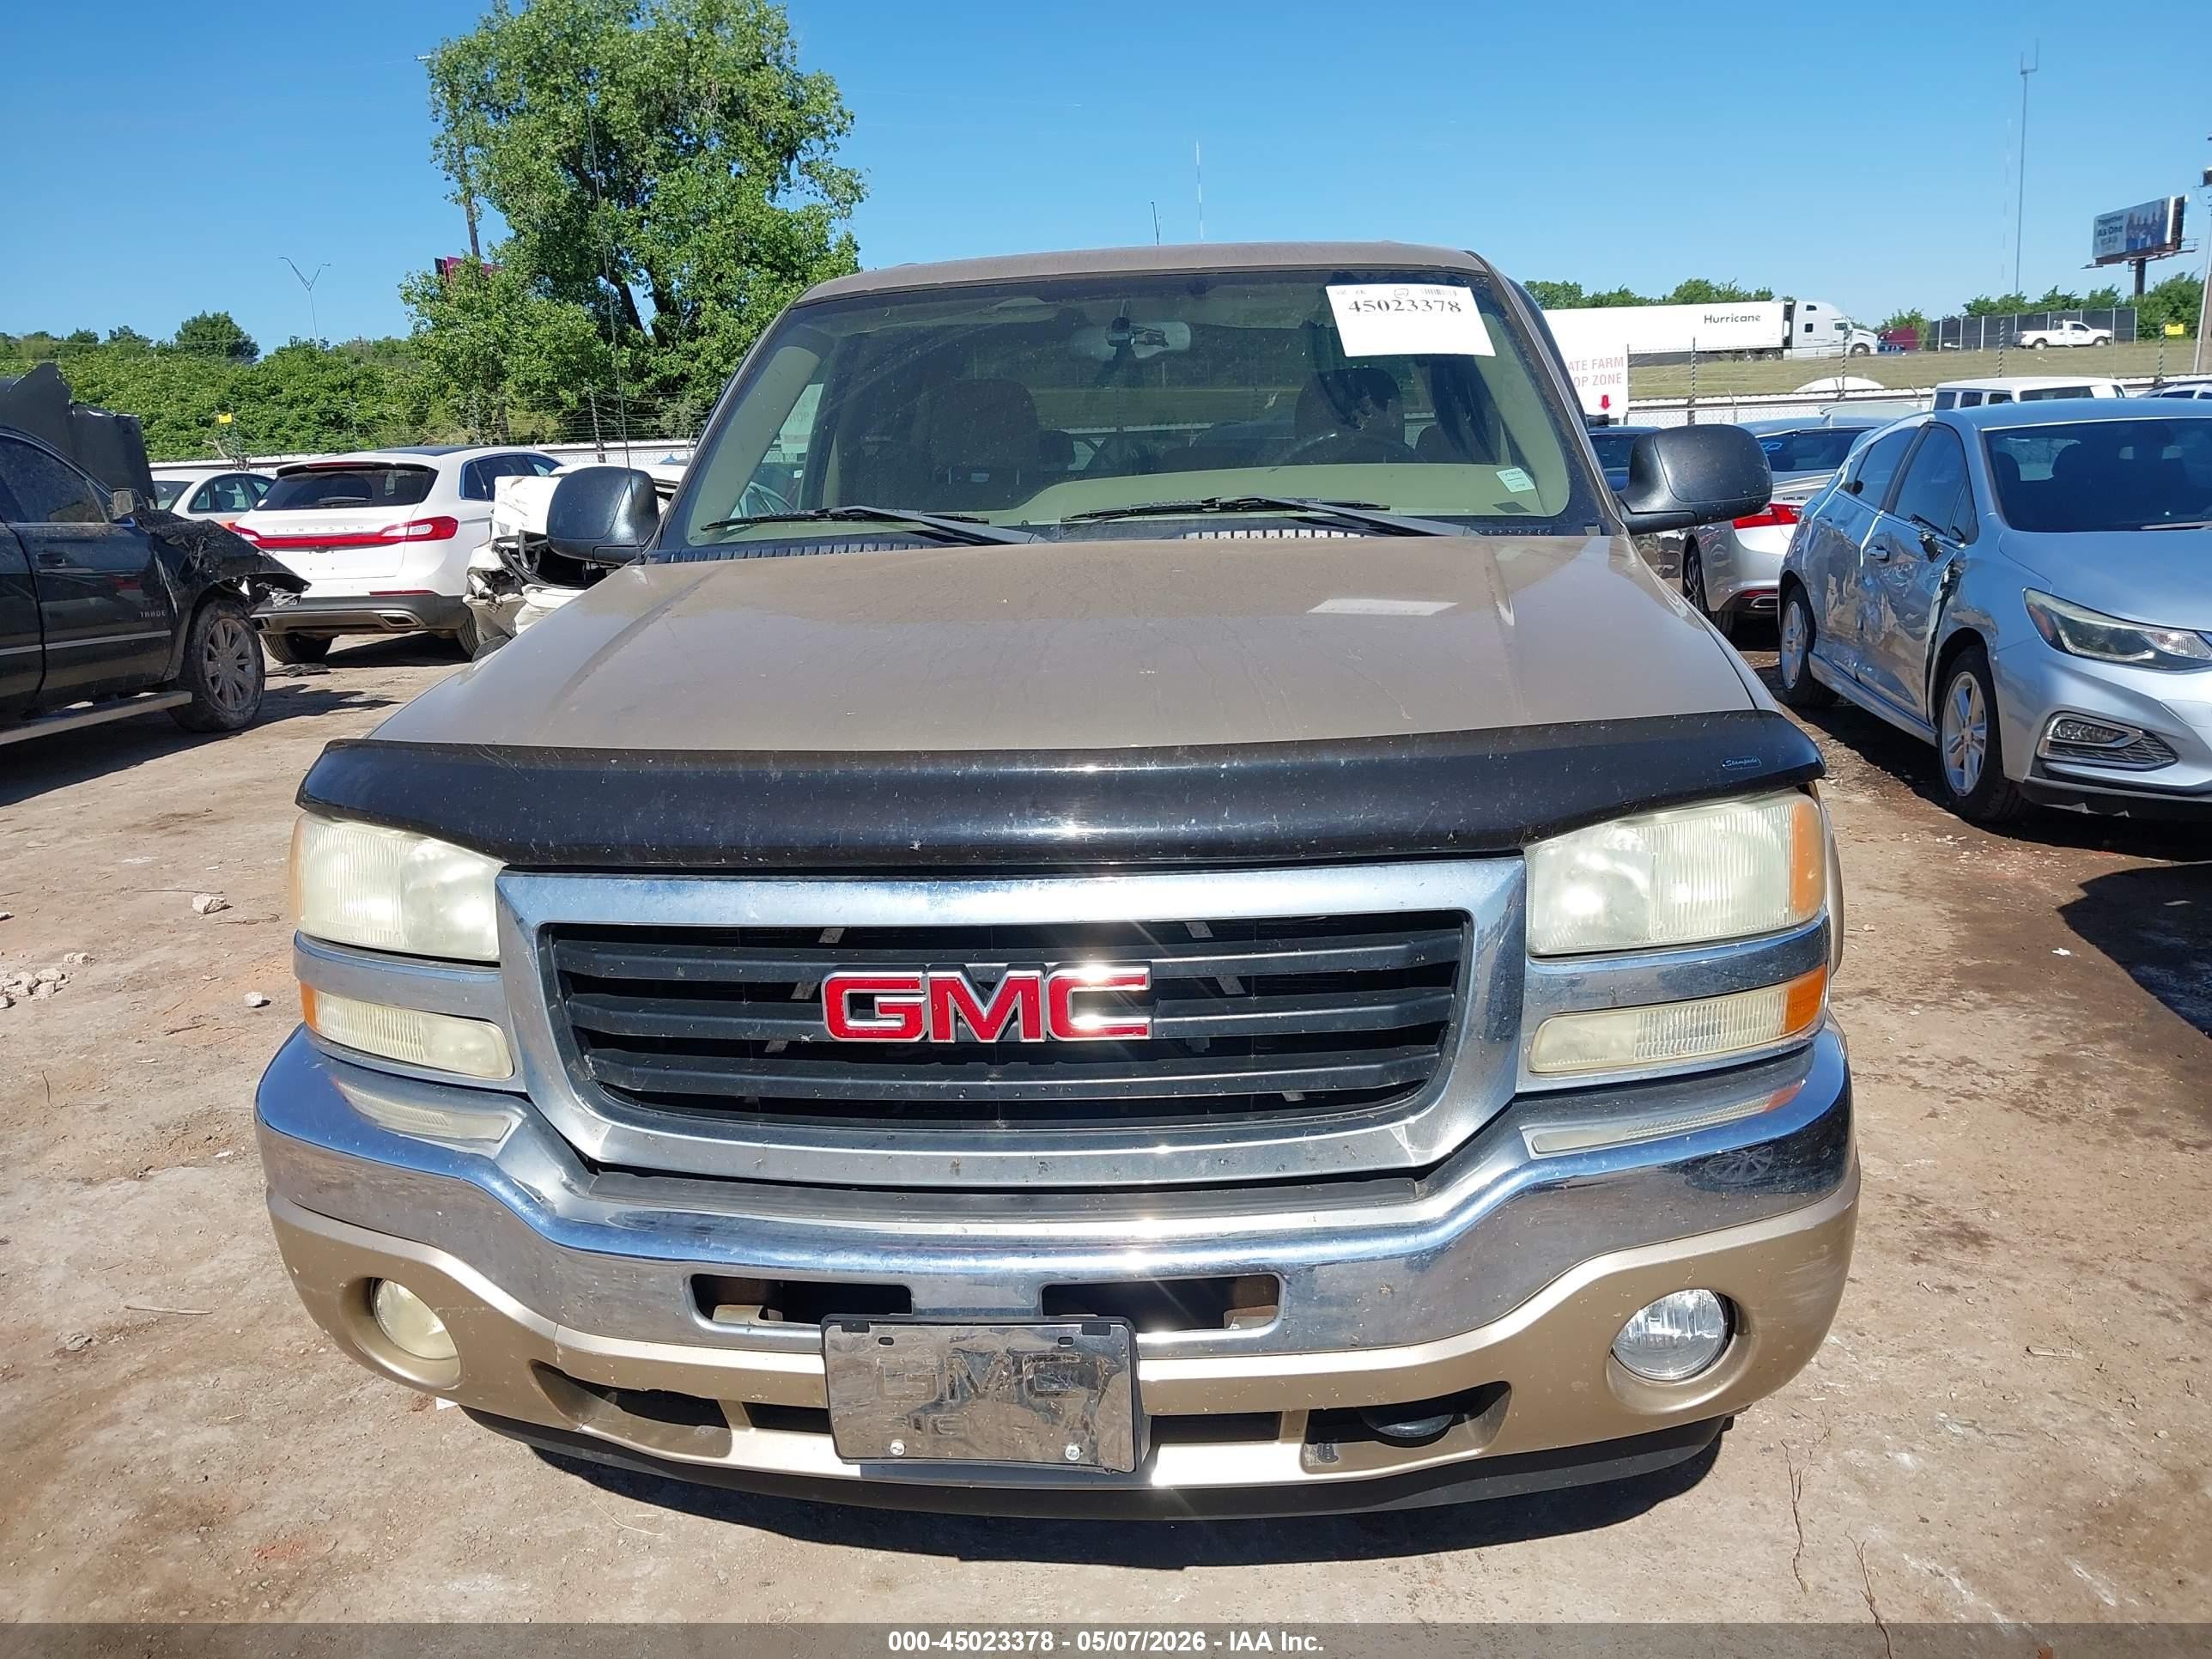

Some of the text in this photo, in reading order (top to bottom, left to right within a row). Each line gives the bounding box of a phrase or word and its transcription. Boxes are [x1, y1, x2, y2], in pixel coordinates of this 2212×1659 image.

[1348, 299, 1462, 313] 45023378
[1704, 313, 1761, 325] Hurricane
[1568, 356, 1624, 372] ATE FARM
[1593, 373, 1622, 386] ZONE
[822, 968, 1152, 1043] GMC
[875, 1352, 1084, 1403] GMC
